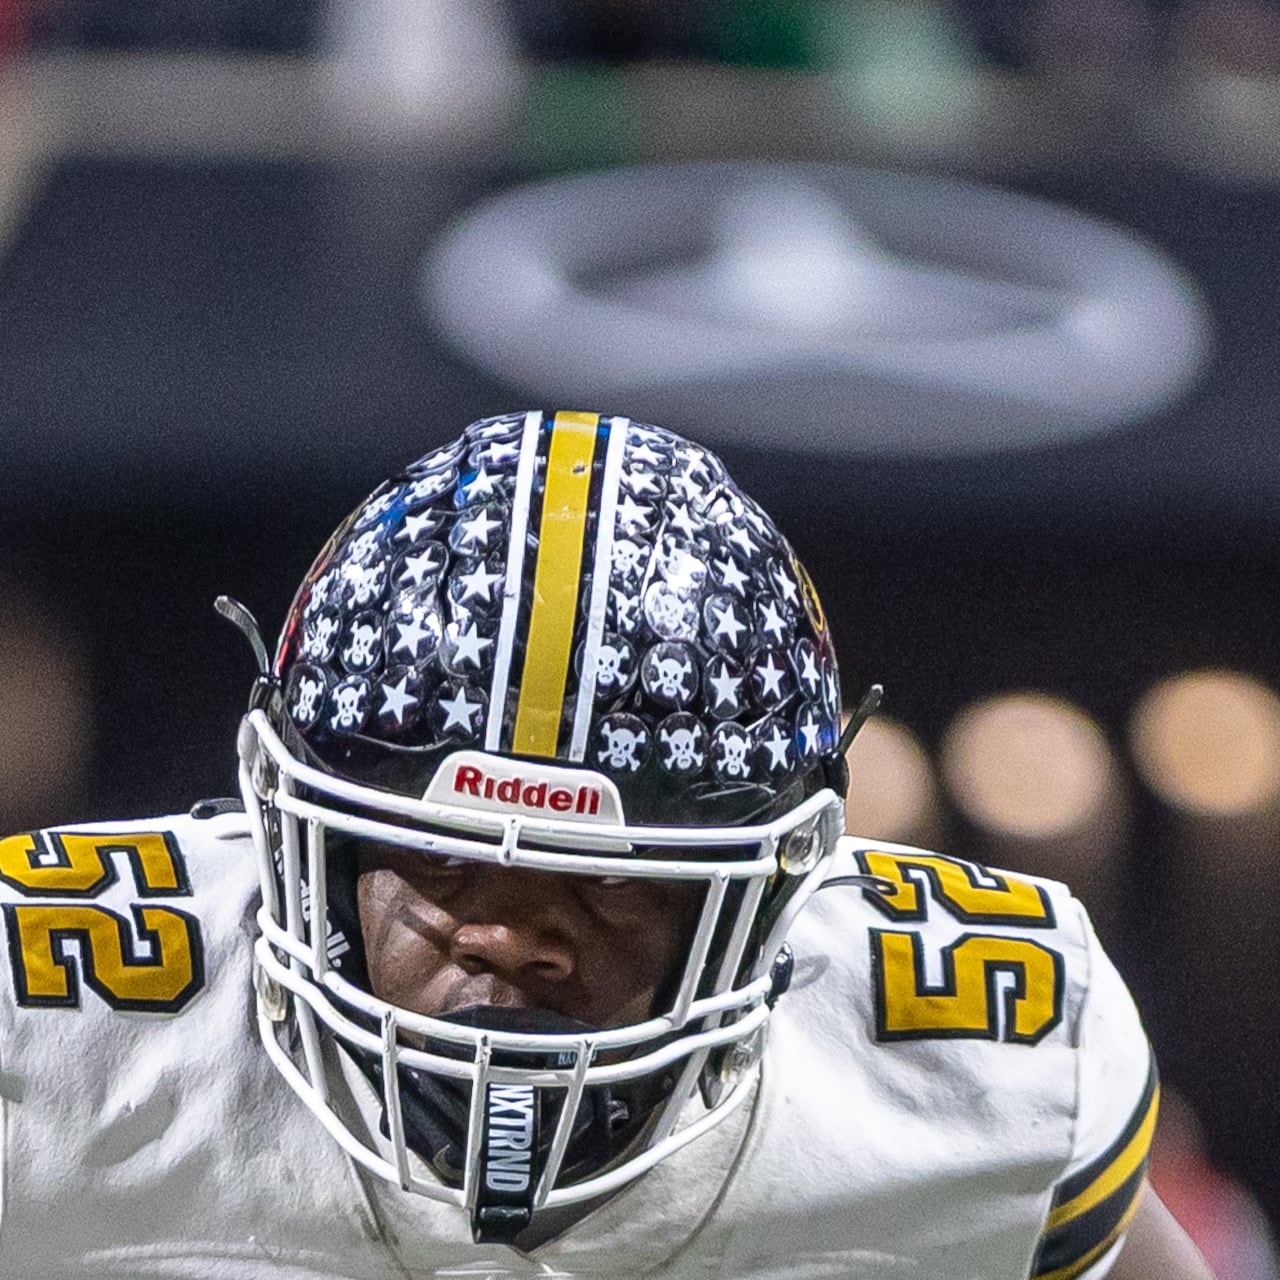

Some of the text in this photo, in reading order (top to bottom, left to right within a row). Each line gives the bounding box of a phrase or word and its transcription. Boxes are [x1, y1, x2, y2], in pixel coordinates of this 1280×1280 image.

[452, 764, 602, 816] Riddell
[852, 849, 1065, 1047] 52
[485, 1083, 534, 1192] NXTRND
